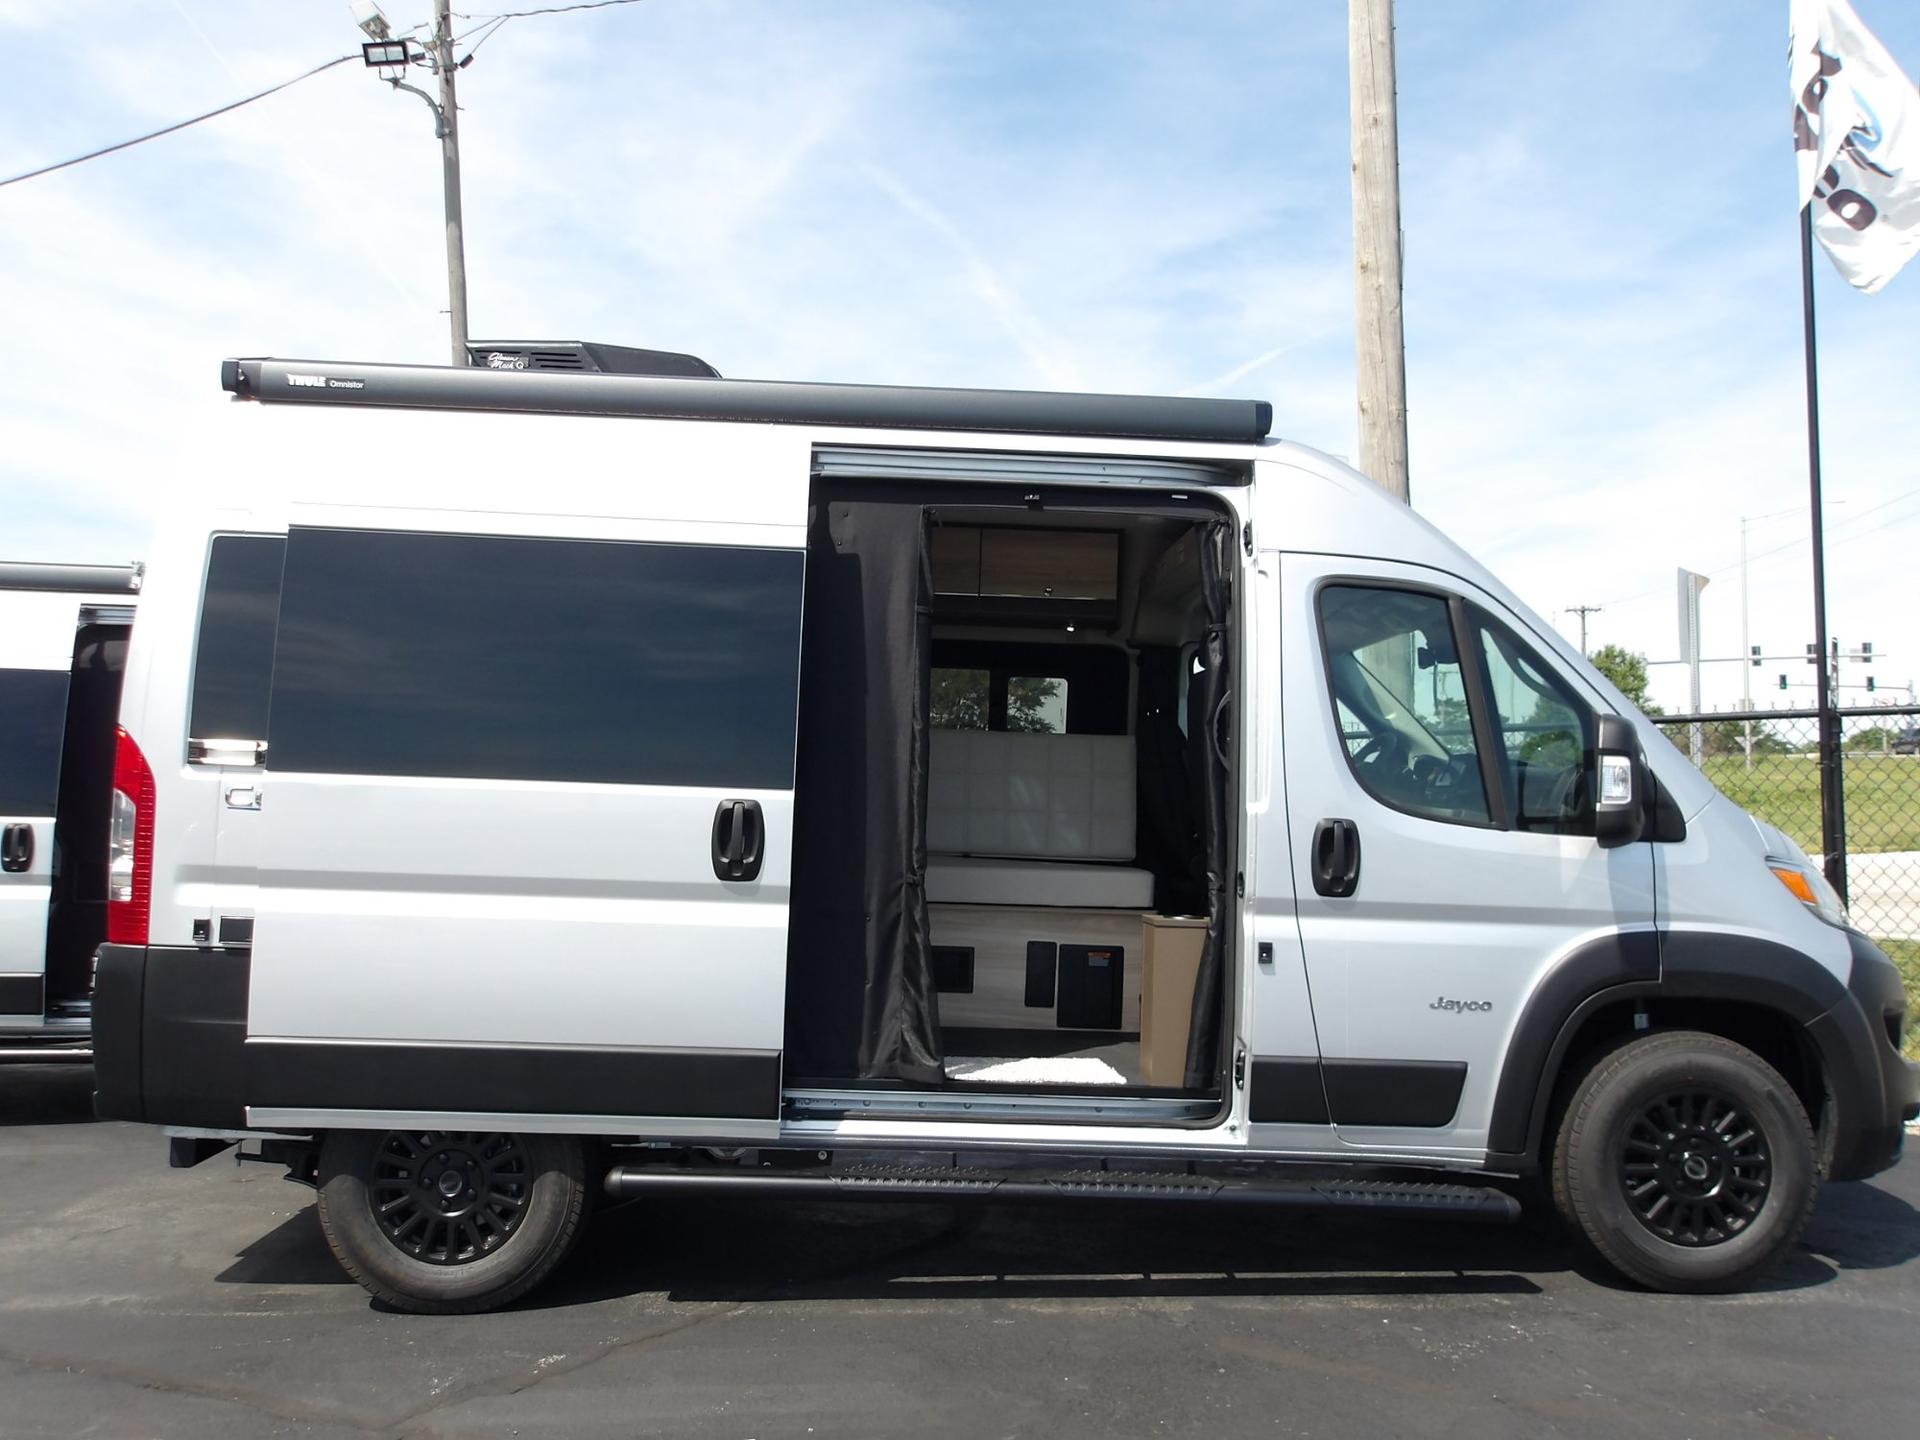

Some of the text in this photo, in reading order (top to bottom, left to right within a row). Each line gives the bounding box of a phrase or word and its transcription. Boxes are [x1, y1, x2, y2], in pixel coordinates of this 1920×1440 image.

[287, 373, 364, 389] THULE Omnistor
[1429, 996, 1492, 1014] Jayco
